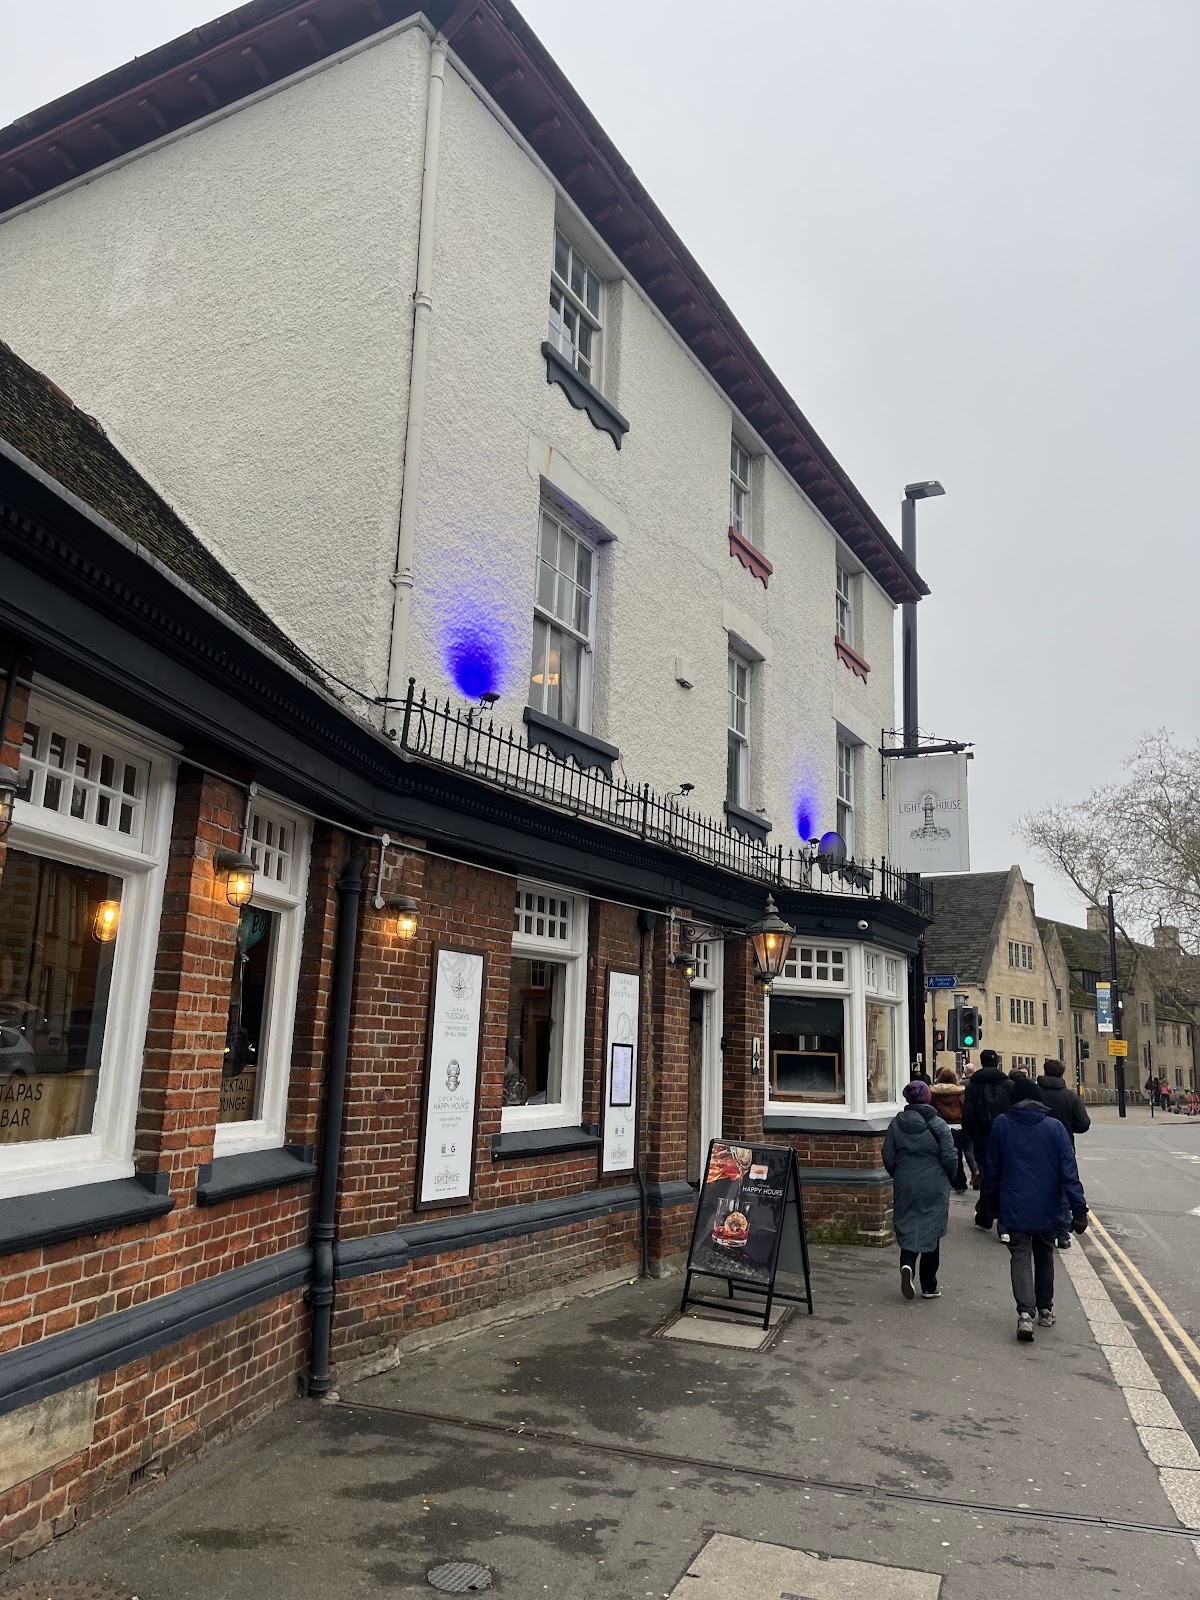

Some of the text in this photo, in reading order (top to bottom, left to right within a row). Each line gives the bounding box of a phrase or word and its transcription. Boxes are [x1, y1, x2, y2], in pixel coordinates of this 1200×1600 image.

[899, 800, 962, 813] LIGHT HOUSE
[445, 1011, 470, 1021] TUESDAYS
[220, 1078, 250, 1092] CKTAIL
[0, 1083, 43, 1102] TAPAS
[218, 1096, 246, 1112] OUNGE
[434, 1102, 469, 1110] HAPPY HOURS
[0, 1108, 30, 1128] BAR
[742, 1185, 763, 1194] HAPPY
[763, 1188, 783, 1196] HOURS
